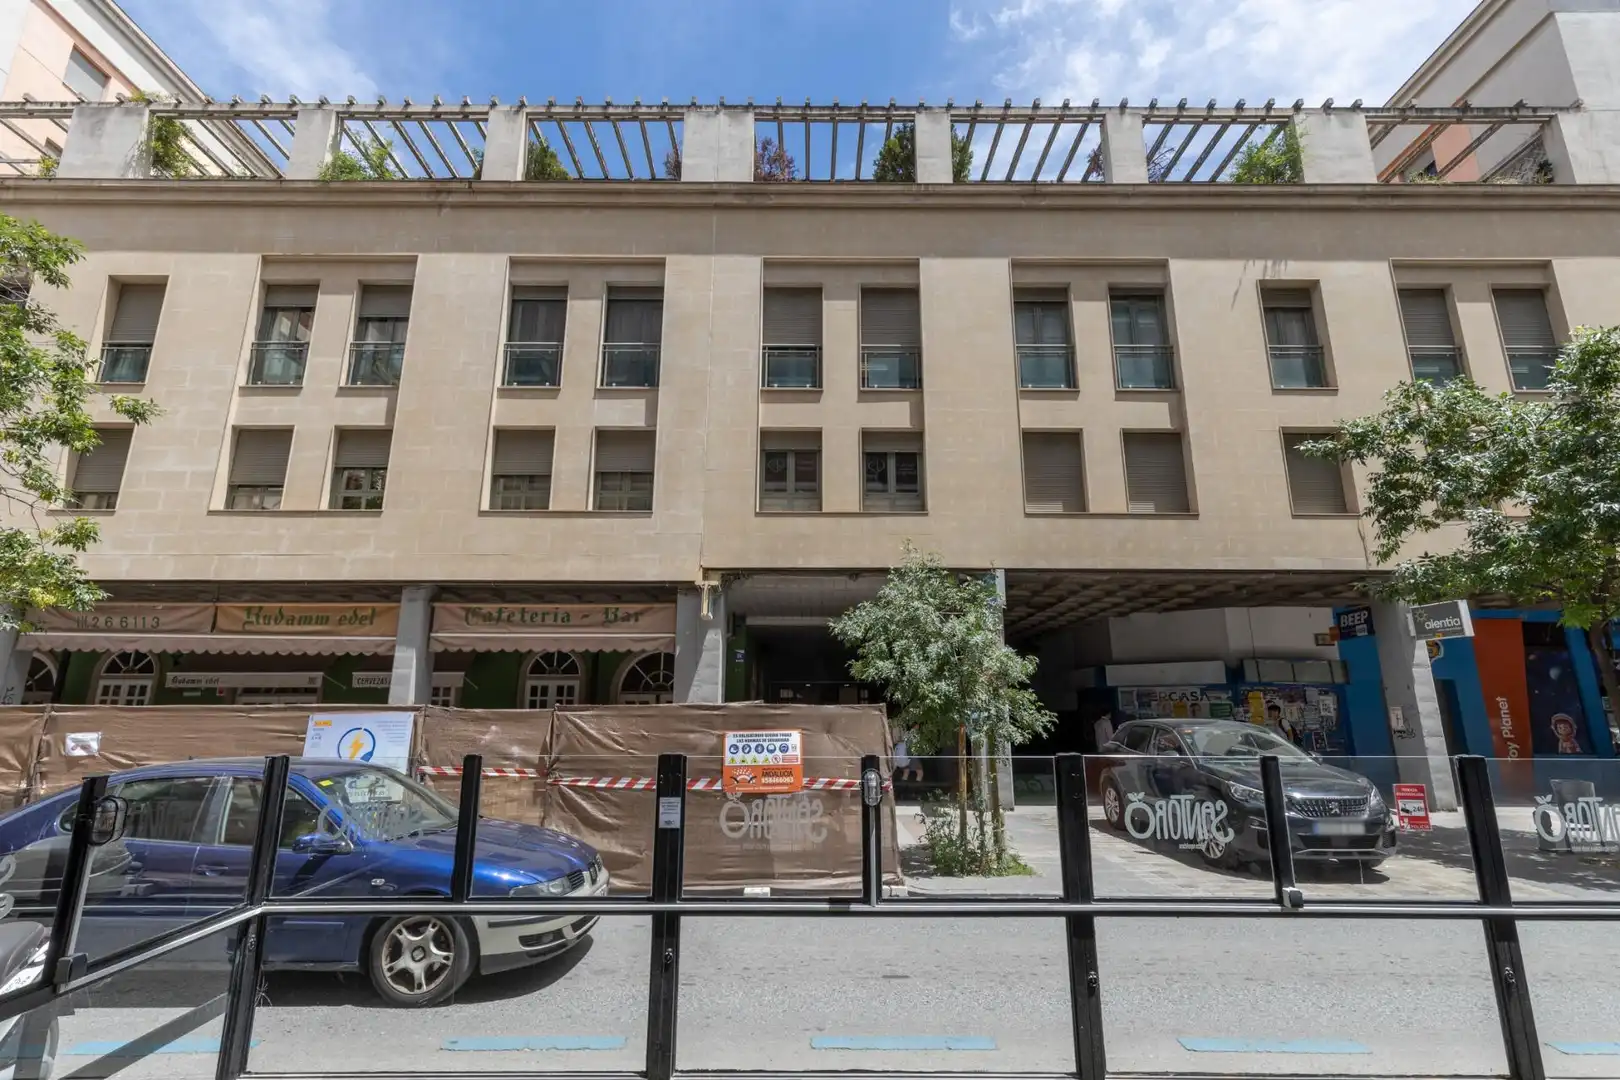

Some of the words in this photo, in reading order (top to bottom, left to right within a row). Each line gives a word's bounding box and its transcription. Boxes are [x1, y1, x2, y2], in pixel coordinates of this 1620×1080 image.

[603, 606, 645, 625] Bar
[1340, 610, 1368, 627] BEEP
[1496, 696, 1515, 738] Planet
